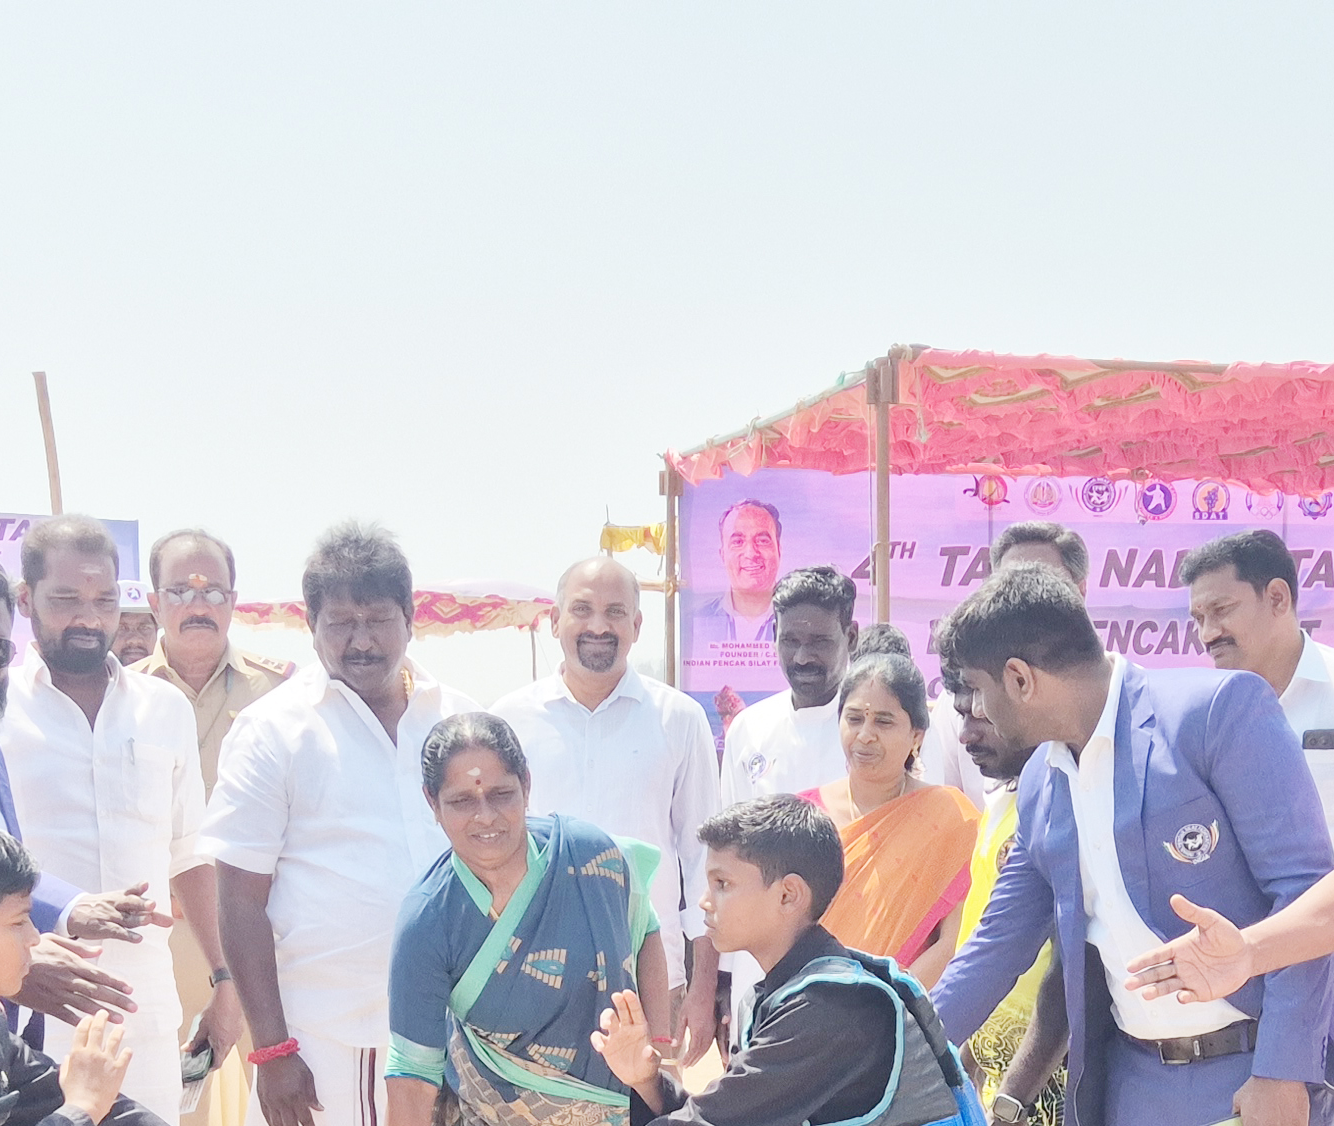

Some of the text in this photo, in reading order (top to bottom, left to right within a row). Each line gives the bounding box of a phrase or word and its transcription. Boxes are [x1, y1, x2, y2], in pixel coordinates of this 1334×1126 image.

[1194, 511, 1226, 520] SDAT
[1099, 548, 1190, 589] NA
[1093, 620, 1205, 656] NCAK
